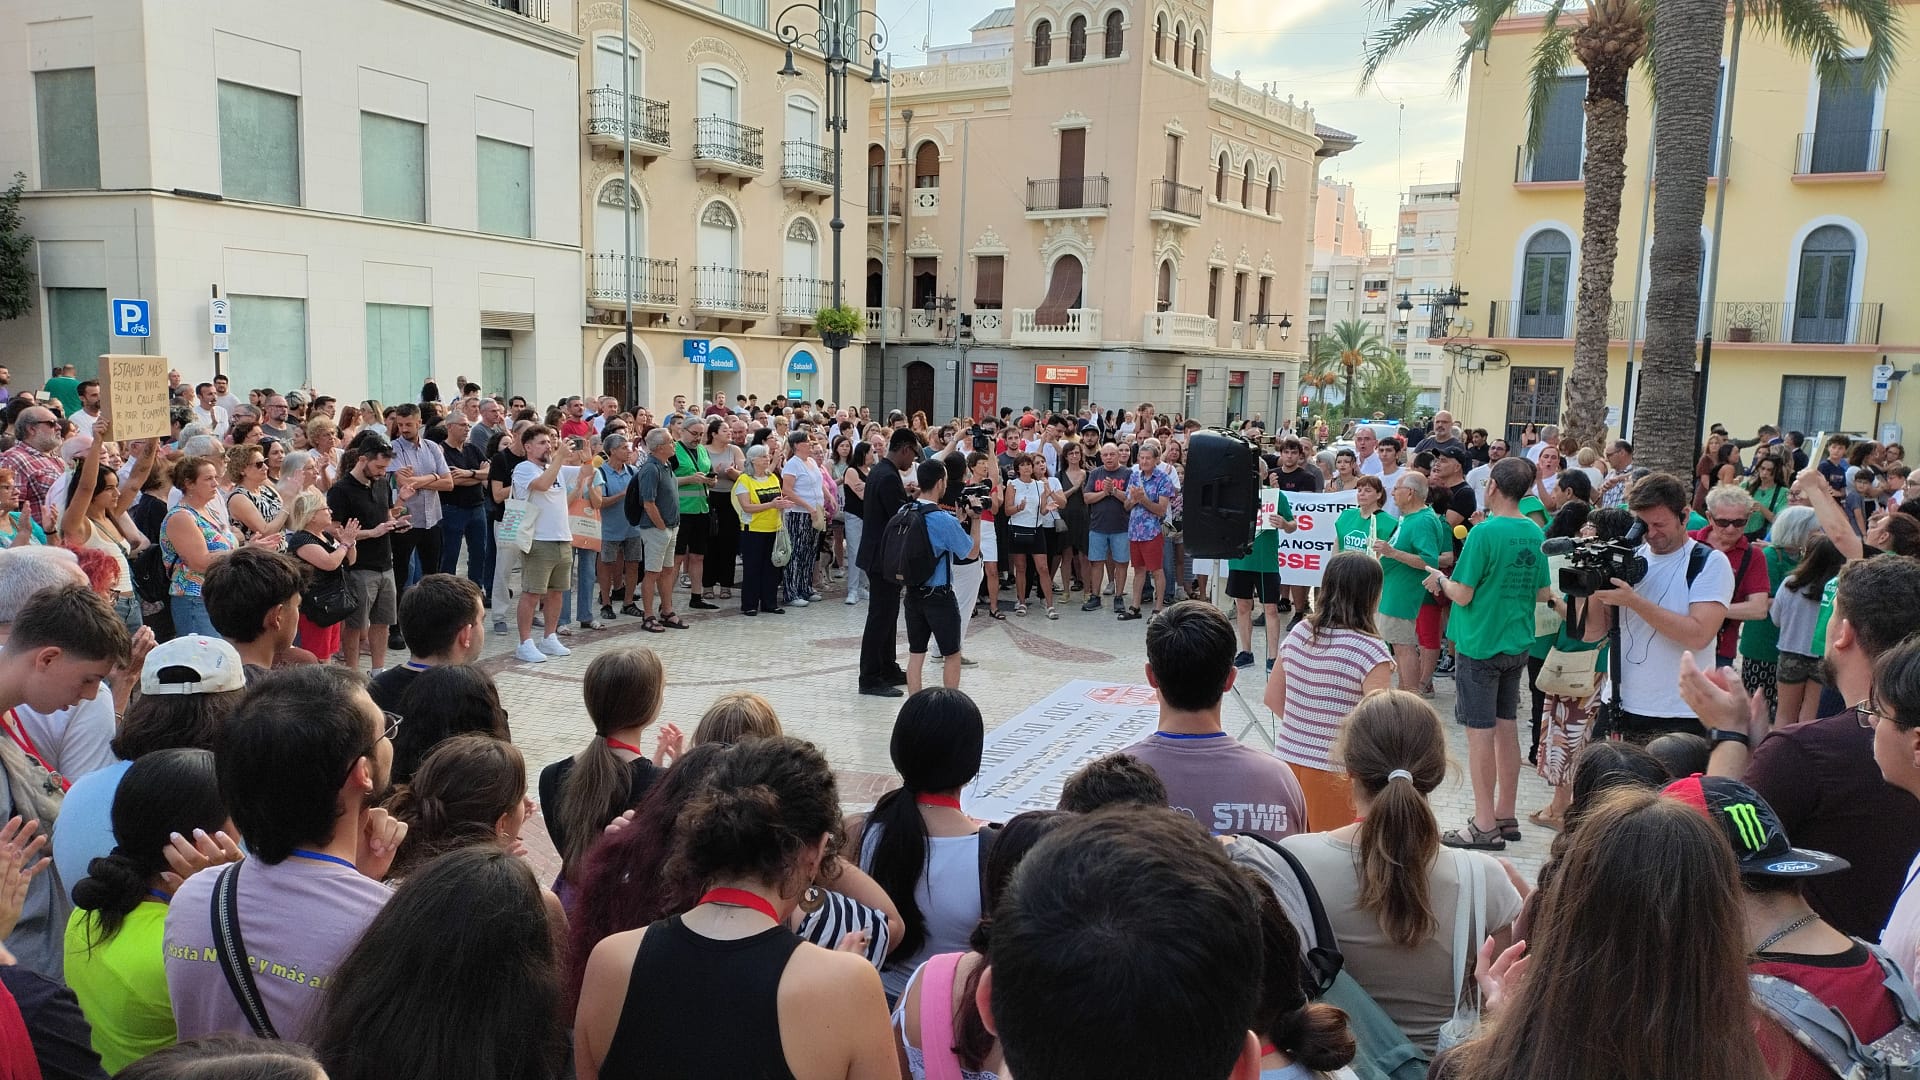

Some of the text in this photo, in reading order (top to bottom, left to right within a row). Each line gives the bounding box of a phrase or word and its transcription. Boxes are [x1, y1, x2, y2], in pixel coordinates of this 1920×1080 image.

[121, 304, 142, 332] P
[692, 355, 707, 363] ATM
[710, 359, 734, 368] Sabadell
[113, 362, 145, 378] ESTAMOS
[793, 362, 813, 370] Sabadell
[113, 381, 131, 392] CERCA
[145, 381, 160, 391] VIVIR
[125, 396, 133, 405] LA
[137, 394, 154, 406] CALLE
[141, 422, 154, 433] PISO
[1292, 540, 1334, 552] NOST
[1345, 536, 1367, 548] STOP
[1040, 701, 1085, 721] STOP
[1213, 803, 1288, 832] STWD
[1777, 862, 1812, 871] Ford
[259, 959, 270, 974] y
[271, 964, 306, 984] más
